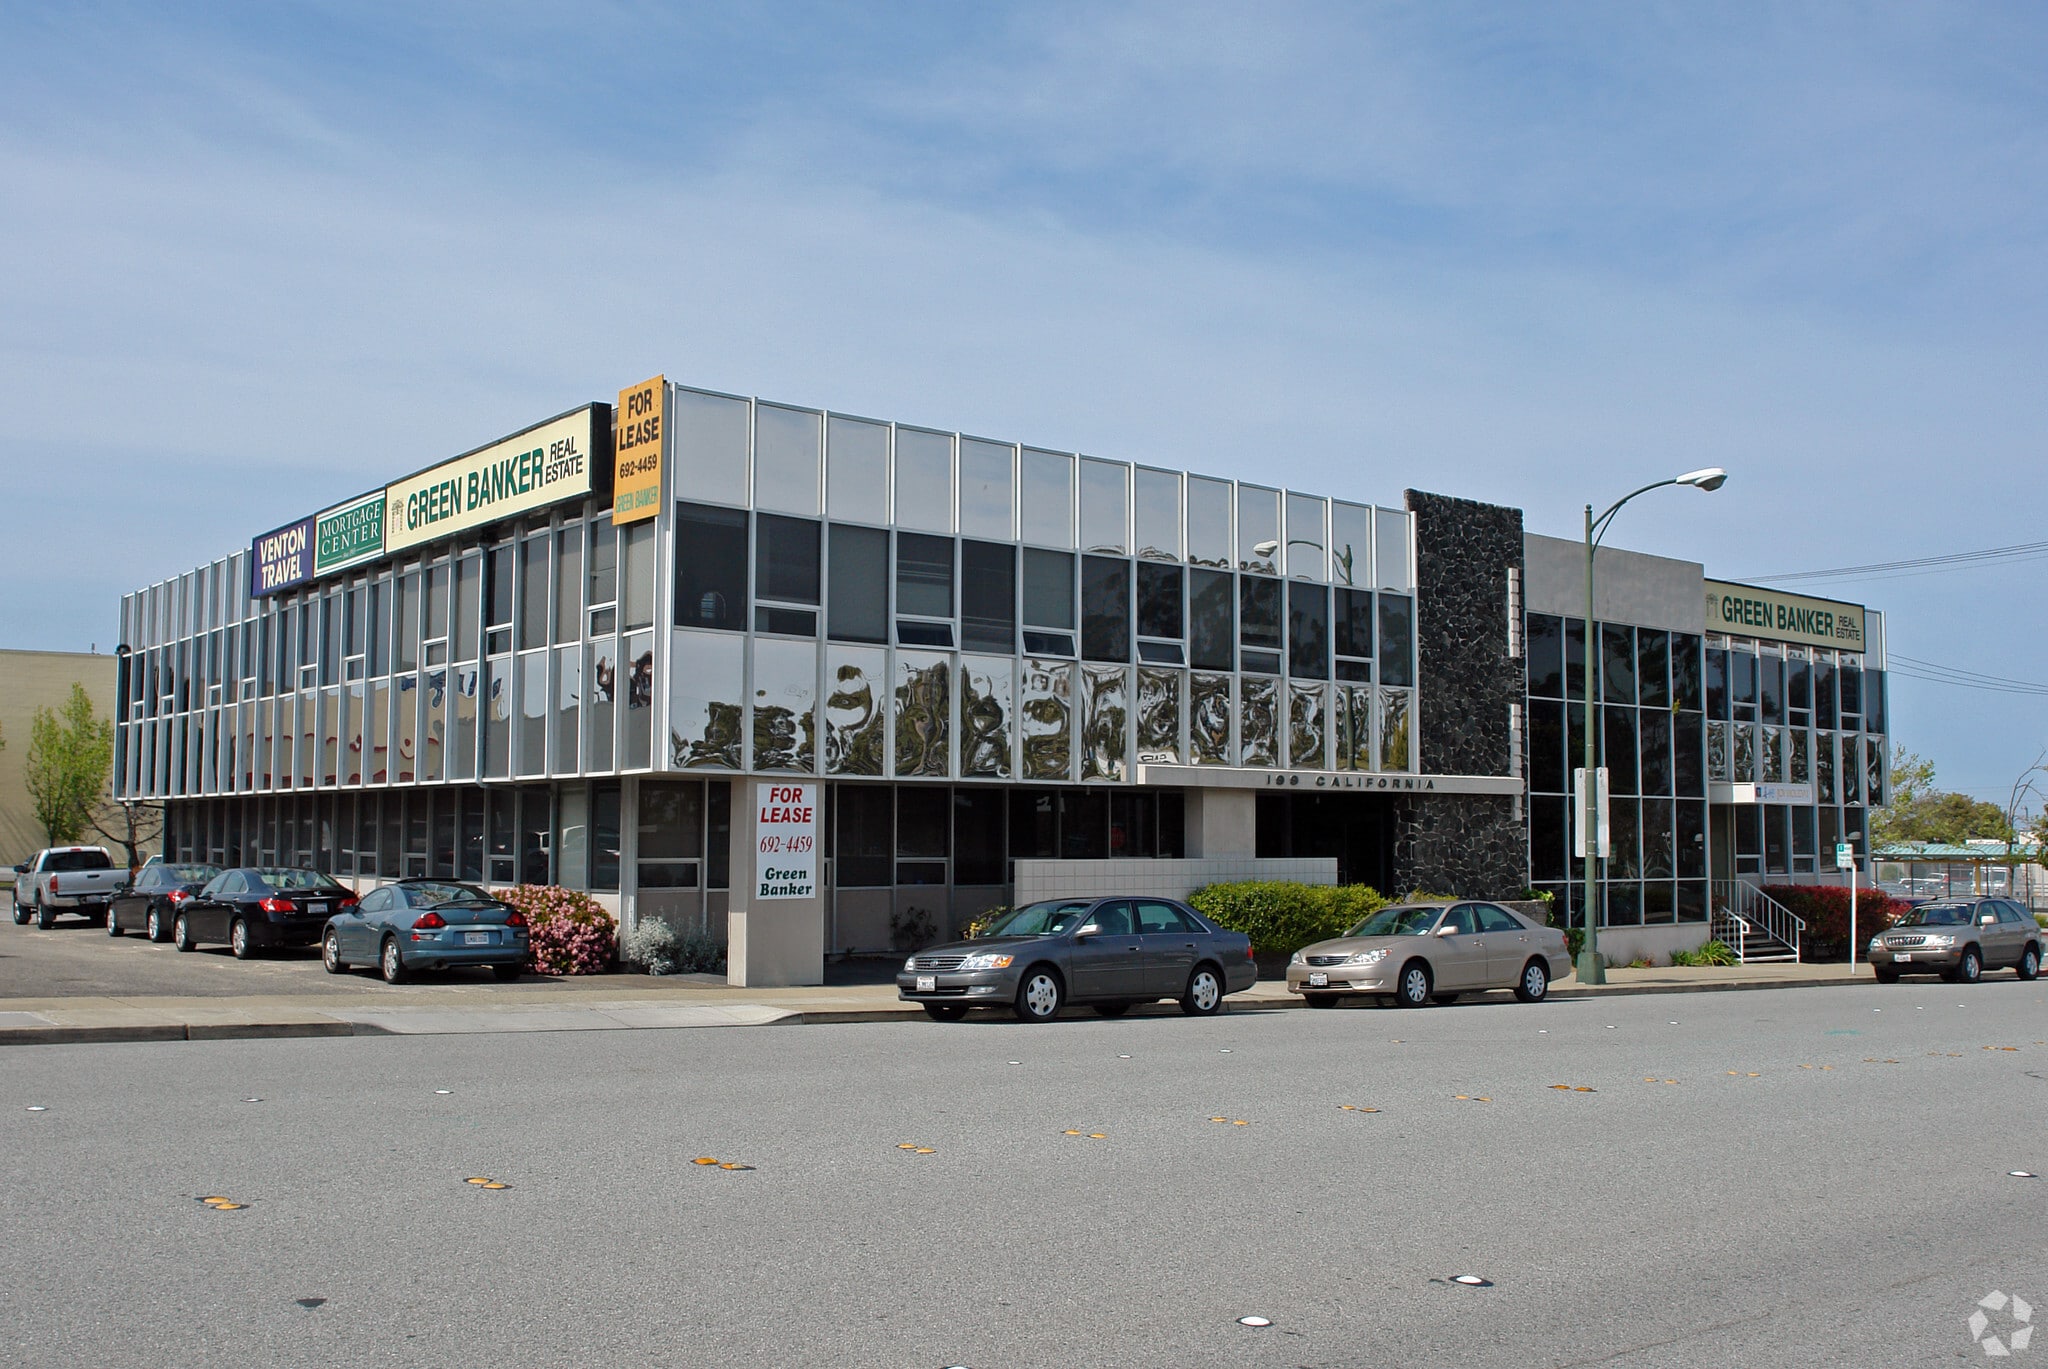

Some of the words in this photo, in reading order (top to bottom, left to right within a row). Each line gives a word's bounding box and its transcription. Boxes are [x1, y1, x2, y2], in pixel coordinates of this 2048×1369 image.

[628, 388, 653, 419] FOR
[619, 416, 660, 451] LEASE
[549, 436, 577, 462] REAL
[545, 454, 584, 485] ESTATE
[619, 453, 658, 479] 692-4459
[407, 476, 463, 531] GREEN
[467, 447, 545, 511] BANKER
[616, 491, 634, 513] GREEN
[635, 485, 659, 509] BANKER
[321, 502, 380, 539] MORTGAGE
[259, 525, 307, 564] VENTON
[321, 522, 379, 556] CENTER
[261, 554, 302, 589] TRAVEL
[1722, 595, 1773, 629] GREEN
[1777, 604, 1834, 637] BANKER
[1838, 615, 1857, 629] REAL
[1836, 627, 1861, 641] ESTATE
[769, 787, 803, 804] FOR
[1315, 775, 1435, 790] CALIFORNIA
[760, 807, 813, 824] LEASE
[760, 835, 813, 853] 692-4459
[765, 867, 807, 881] Green
[760, 883, 812, 897] Banker
